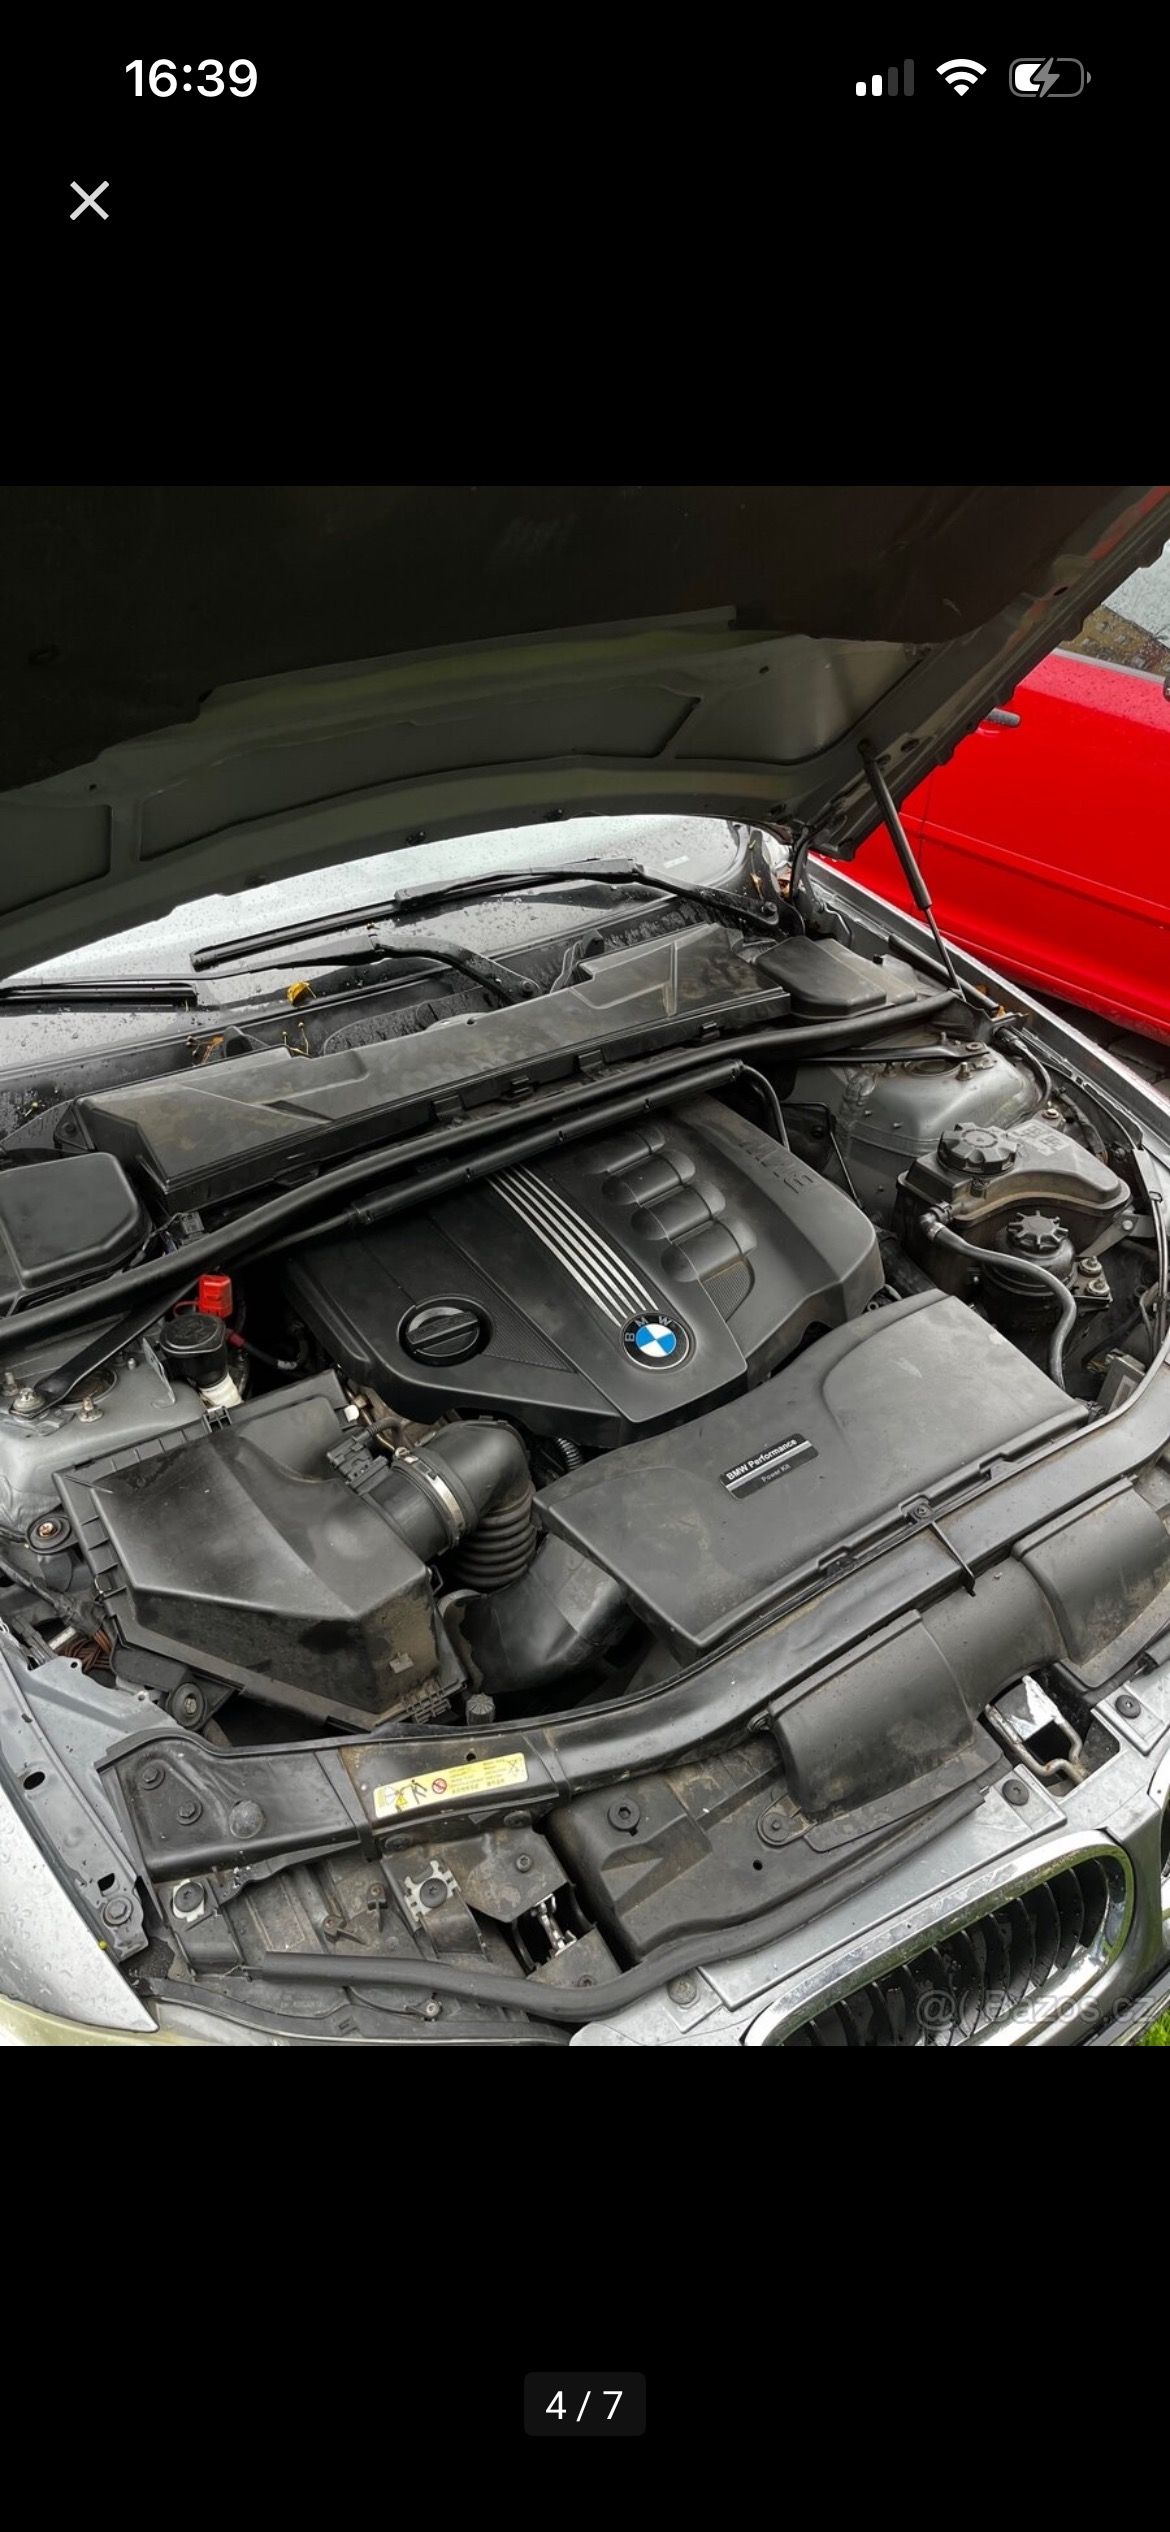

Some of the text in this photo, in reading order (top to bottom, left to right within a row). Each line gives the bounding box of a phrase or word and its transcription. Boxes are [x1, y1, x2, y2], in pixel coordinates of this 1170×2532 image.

[125, 58, 258, 98] 16:39
[624, 1315, 673, 1343] BMW
[726, 1439, 798, 1480] BMW Performance
[545, 2390, 623, 2422] 4 / 7
